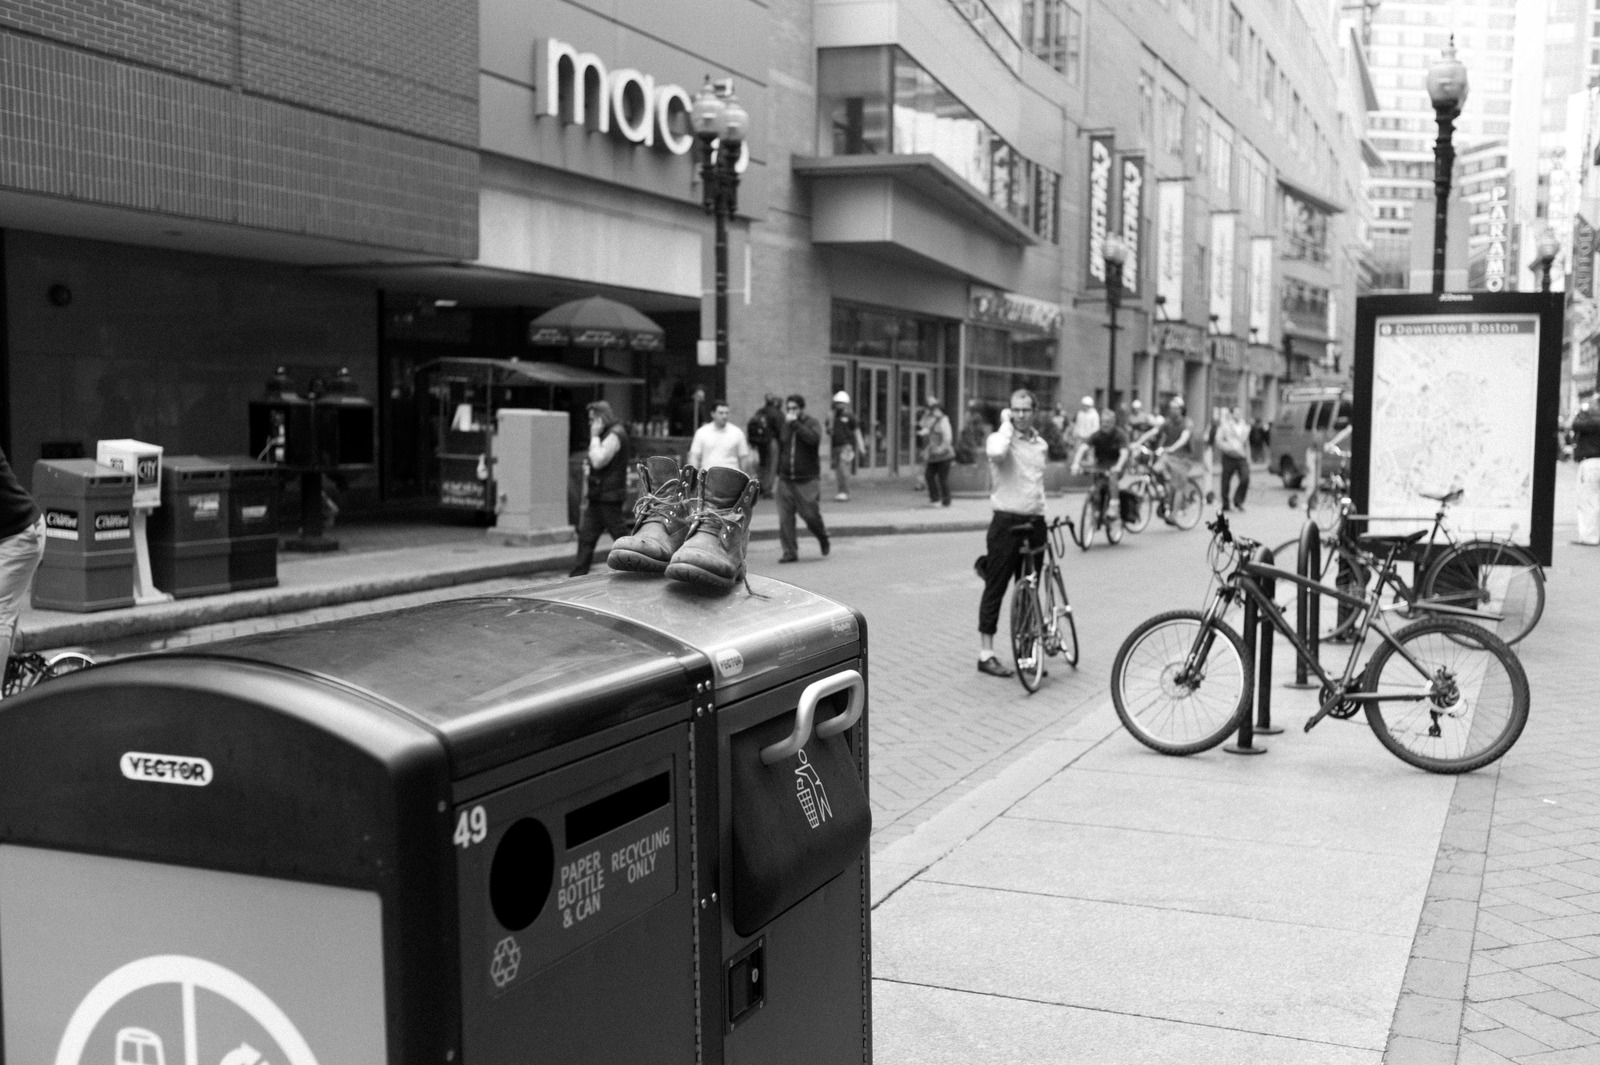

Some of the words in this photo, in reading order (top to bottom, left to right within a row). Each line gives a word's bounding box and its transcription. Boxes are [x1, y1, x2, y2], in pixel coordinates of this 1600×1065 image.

[537, 37, 748, 174] mac
[1396, 323, 1467, 335] Downtown
[1471, 321, 1519, 334] Boston
[128, 757, 206, 782] VECTOR
[452, 804, 488, 849] 49
[611, 826, 671, 873] RECYCLING
[627, 852, 657, 884] ONLY
[561, 850, 602, 888] PAPER
[558, 868, 605, 911] BOTTLE
[563, 908, 574, 929] &
[576, 892, 601, 921] CAN
